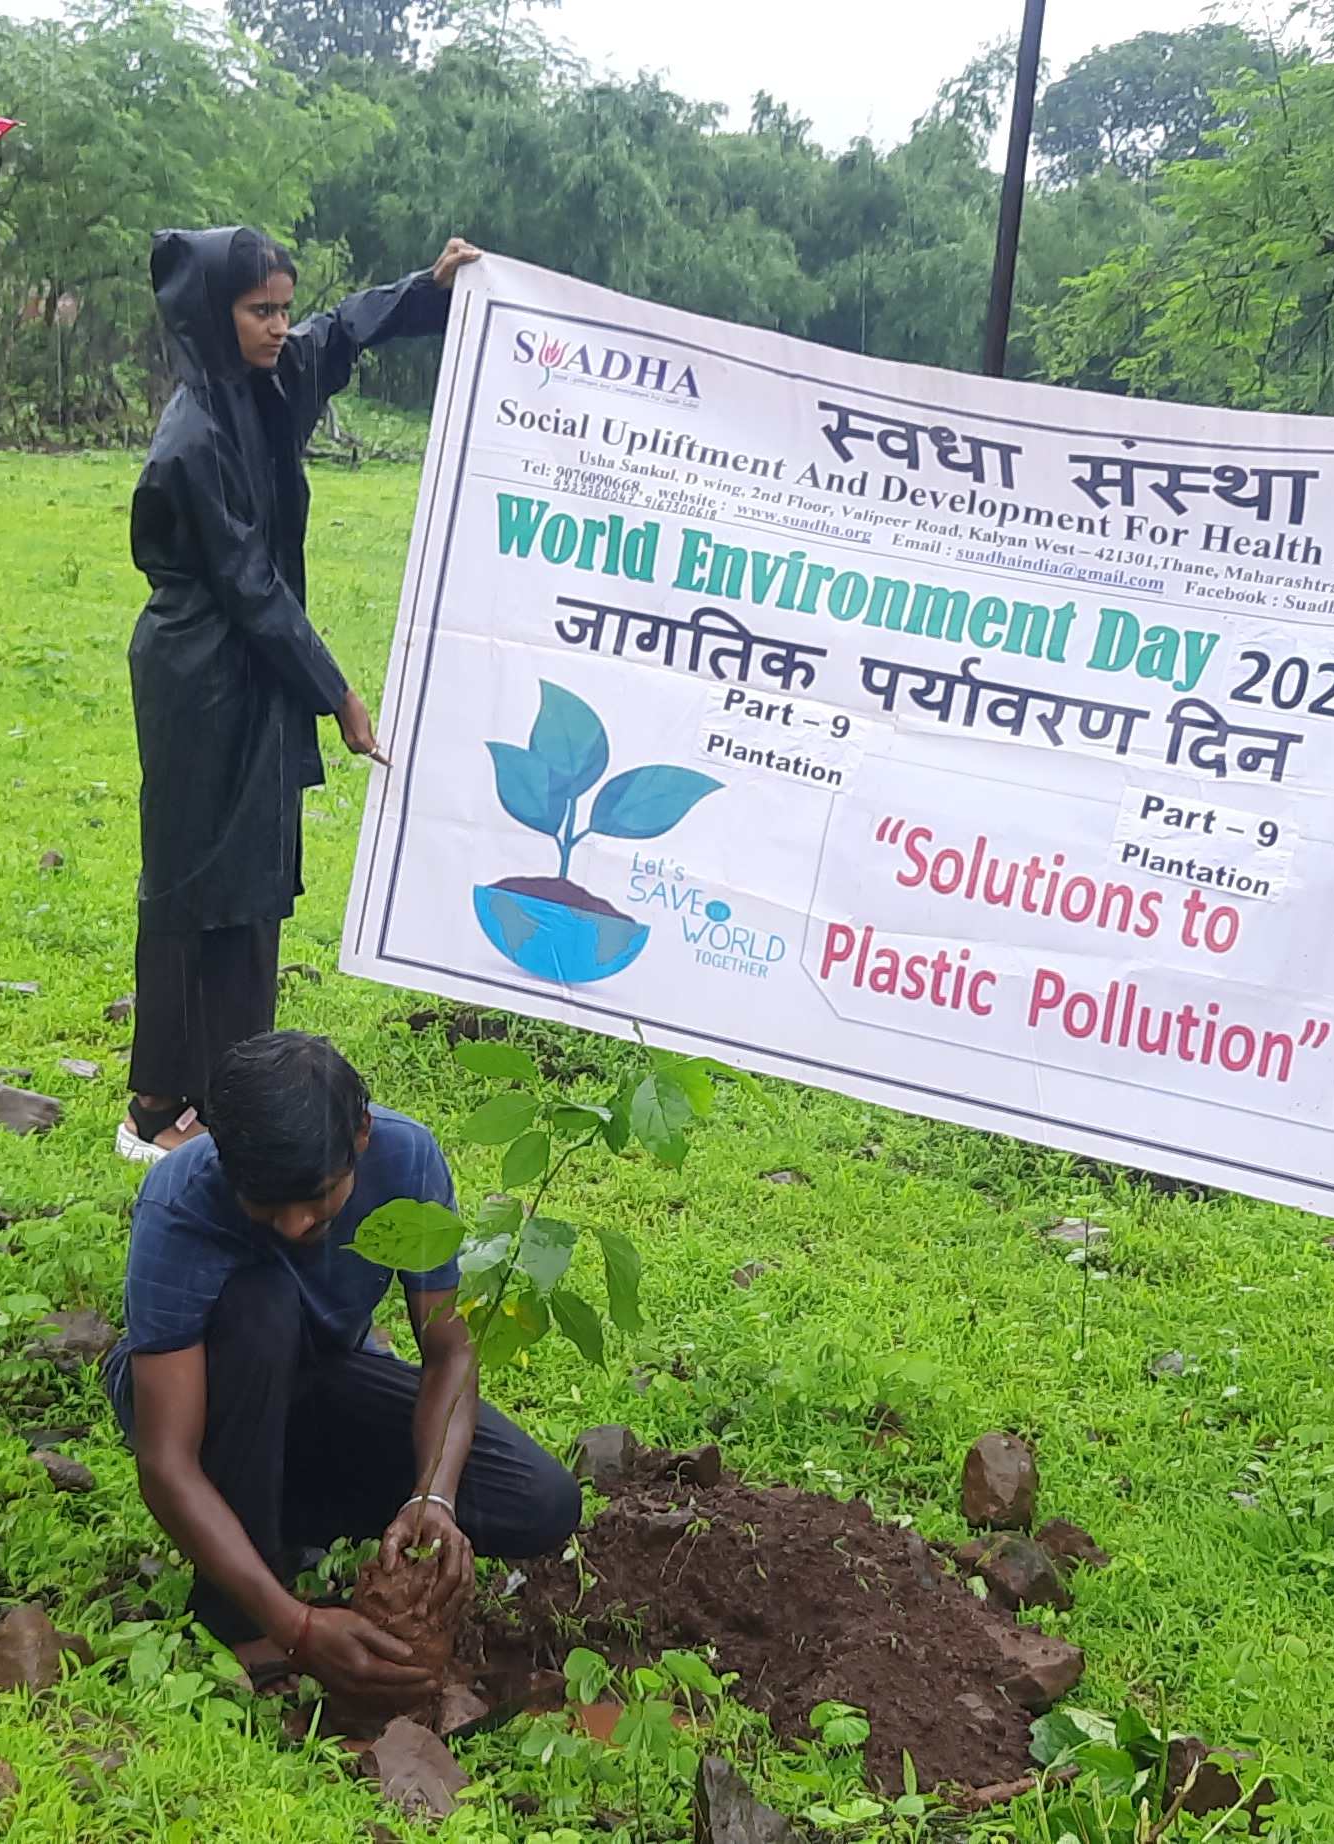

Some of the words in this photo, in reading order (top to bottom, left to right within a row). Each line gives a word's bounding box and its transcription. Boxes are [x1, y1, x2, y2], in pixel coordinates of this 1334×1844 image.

[496, 399, 589, 441] Social
[602, 417, 786, 480] Upliftment
[794, 461, 867, 498] And
[879, 474, 1111, 538] Development
[1122, 514, 1190, 548] For
[1200, 523, 1324, 566] Health
[818, 400, 1023, 489] स्वधा
[1068, 438, 1319, 526] संस्था
[579, 450, 615, 469] Usha
[685, 472, 699, 485] D
[703, 478, 746, 498] wing,
[750, 486, 783, 504] 2nd
[786, 494, 834, 517] Floor,
[915, 518, 963, 540] Road,
[968, 526, 1028, 550] Kalyan
[1034, 536, 1075, 556] West
[734, 504, 873, 544] www.suadha.org
[891, 533, 942, 554] Email
[955, 547, 1164, 593] suadhaindia@gmail.com
[1184, 580, 1267, 605] Facebook
[496, 493, 661, 583] World
[672, 526, 1078, 664] Environment
[1086, 607, 1221, 693] Day
[554, 595, 828, 692] जागतिक
[860, 656, 1150, 756] पर्यावरण
[1165, 698, 1304, 783] दिन
[723, 687, 794, 728] Part
[829, 714, 851, 739] 9
[706, 733, 843, 786] Plantation
[1139, 794, 1216, 835] Part
[1257, 820, 1279, 848] 9
[626, 875, 704, 916] SAVE
[631, 852, 685, 881] Let's
[1120, 843, 1270, 897] Plantation
[681, 915, 786, 962] WORLD
[1181, 889, 1240, 954] to
[695, 949, 769, 979] TOGETHER
[820, 923, 997, 1017] Plastic
